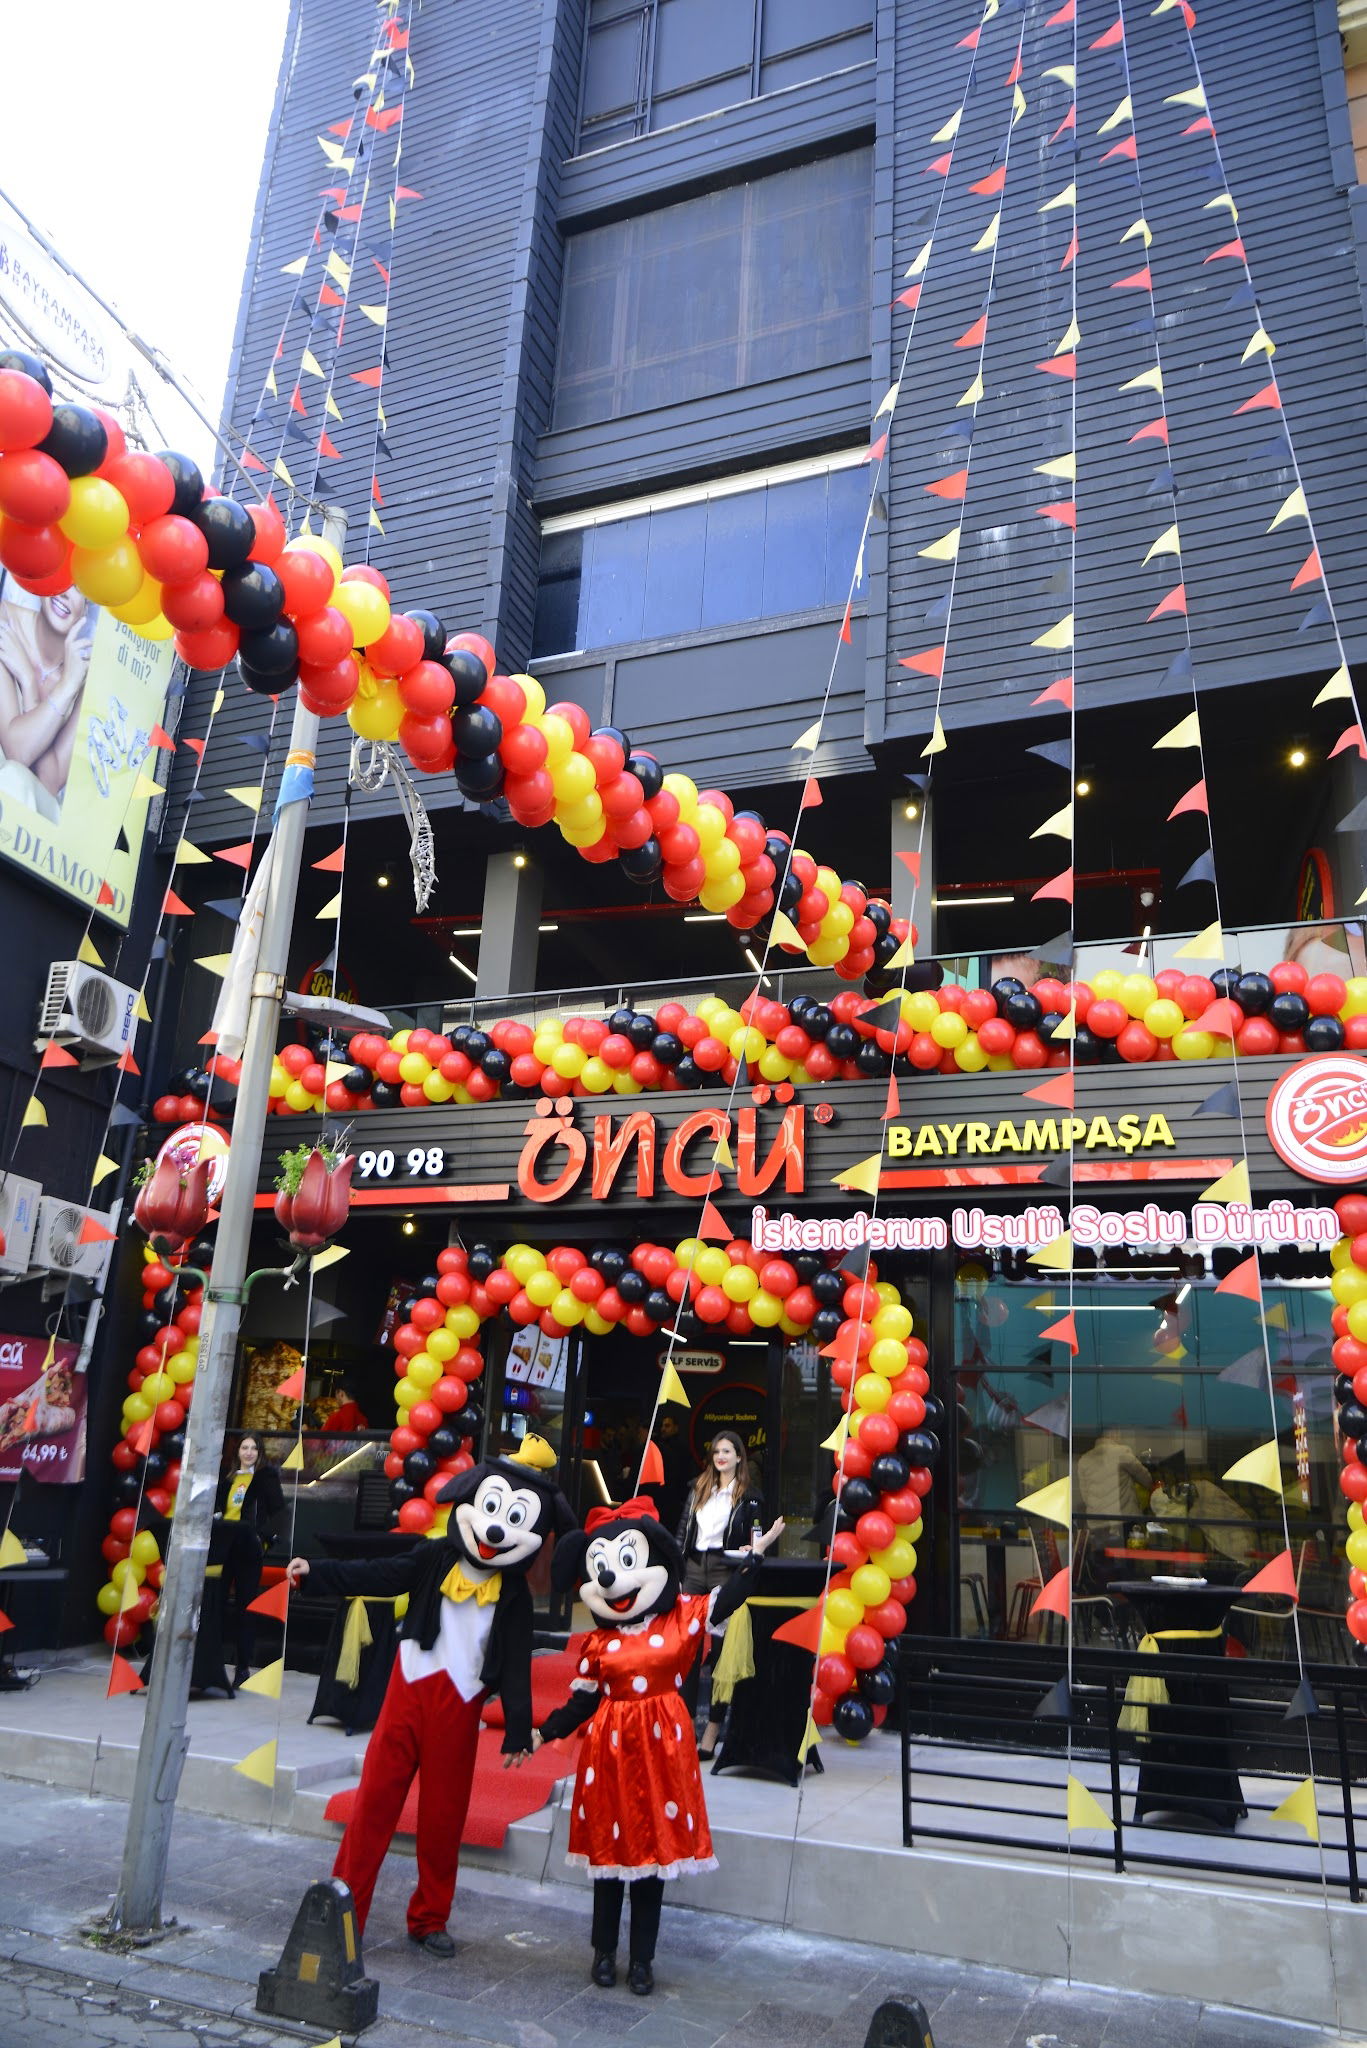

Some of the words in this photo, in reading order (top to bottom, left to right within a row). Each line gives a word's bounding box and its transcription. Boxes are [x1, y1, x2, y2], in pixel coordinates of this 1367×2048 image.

[117, 644, 129, 666] di
[131, 658, 152, 685] mi?
[14, 824, 125, 914] DIAMOD
[888, 1113, 1176, 1155] BAYRAMPAŞA
[358, 1150, 395, 1178] 90
[407, 1147, 444, 1176] 98
[752, 1205, 947, 1250] İskenderun
[952, 1205, 1064, 1248] Usulü
[1070, 1203, 1187, 1245] Soslu
[1192, 1200, 1340, 1245] Dürüm
[661, 1355, 683, 1366] SLF
[685, 1356, 720, 1367] SERVİS
[22, 1444, 57, 1462] 64,99
